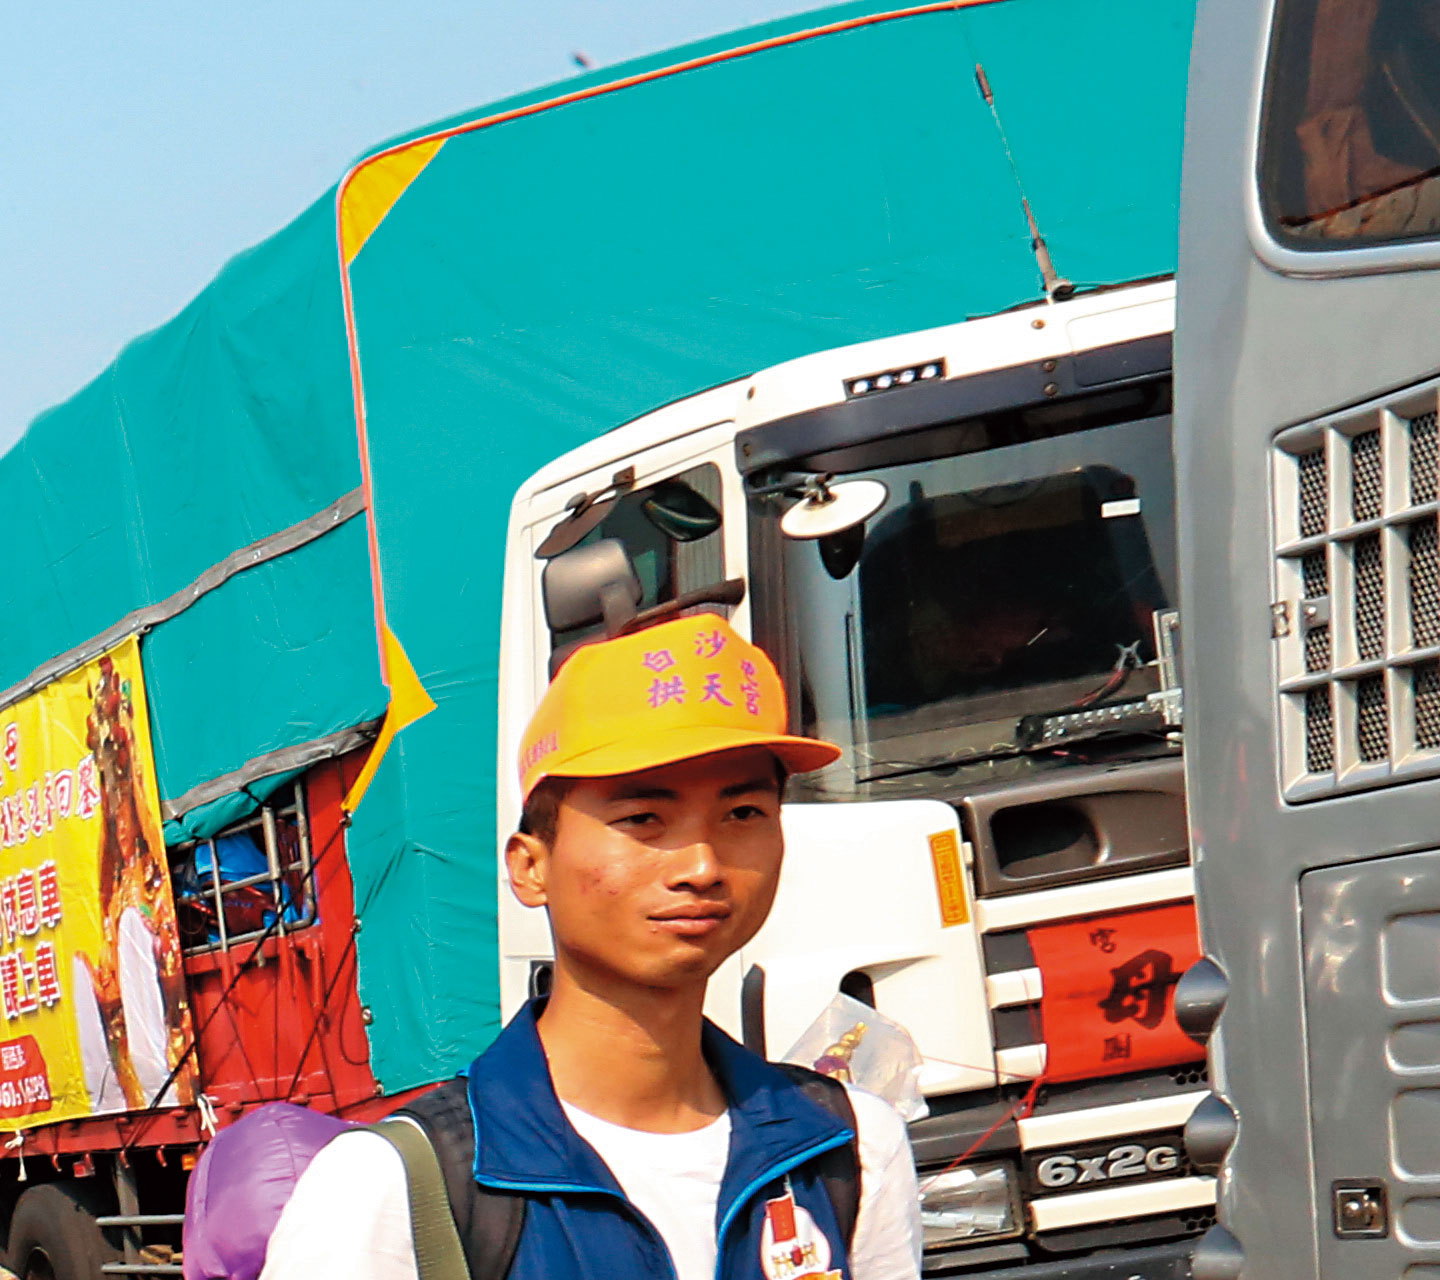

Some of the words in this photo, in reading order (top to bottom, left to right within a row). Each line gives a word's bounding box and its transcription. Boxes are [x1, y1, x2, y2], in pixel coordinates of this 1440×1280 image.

[642, 629, 758, 685] 白沙屯
[647, 673, 762, 716] 拱天宮
